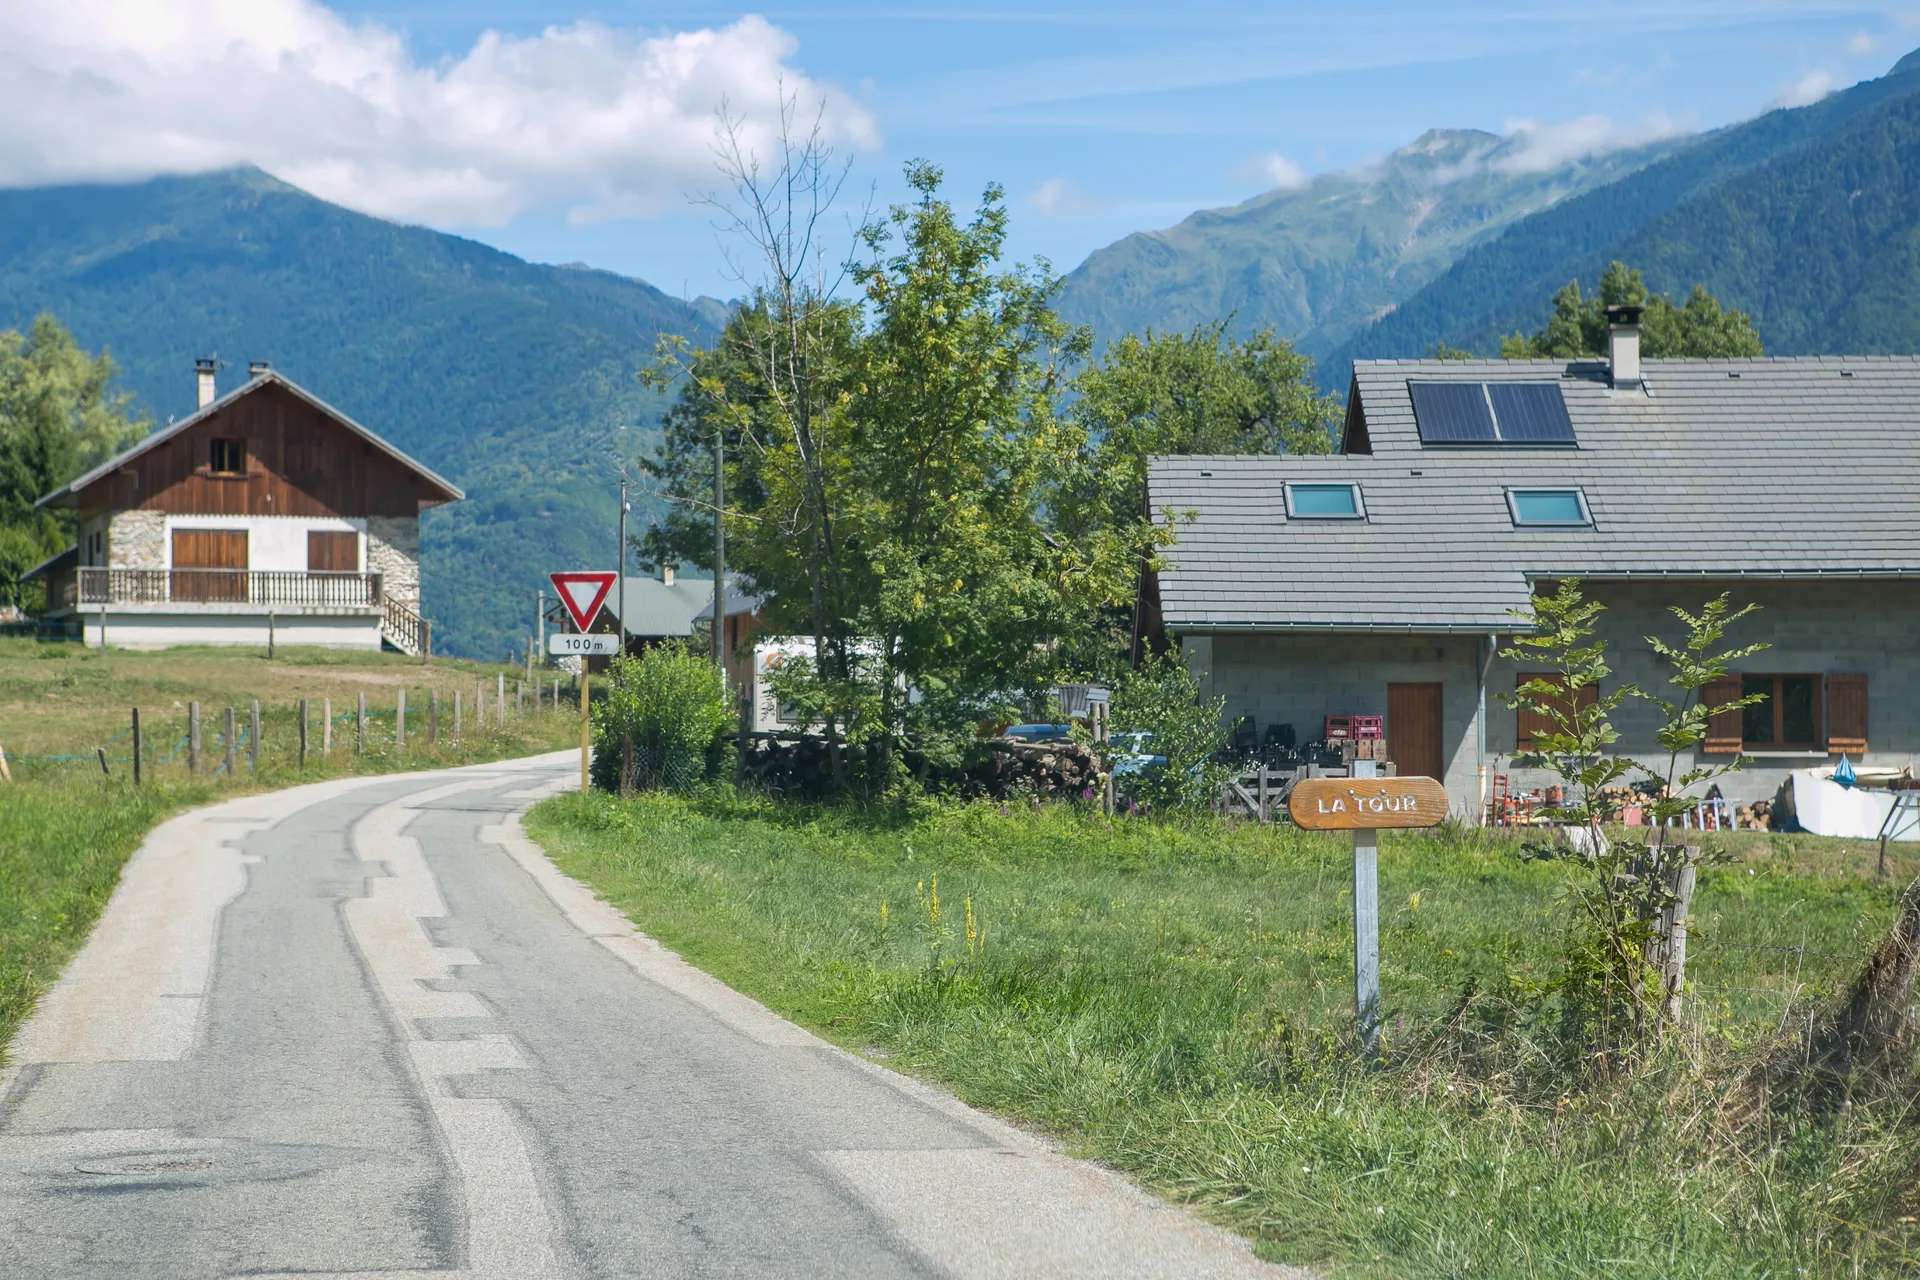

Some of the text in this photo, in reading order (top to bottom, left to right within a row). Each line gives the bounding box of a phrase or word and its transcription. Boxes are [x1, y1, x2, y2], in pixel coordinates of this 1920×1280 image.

[566, 639, 591, 649] 100
[1318, 795, 1418, 814] LA TOUR
